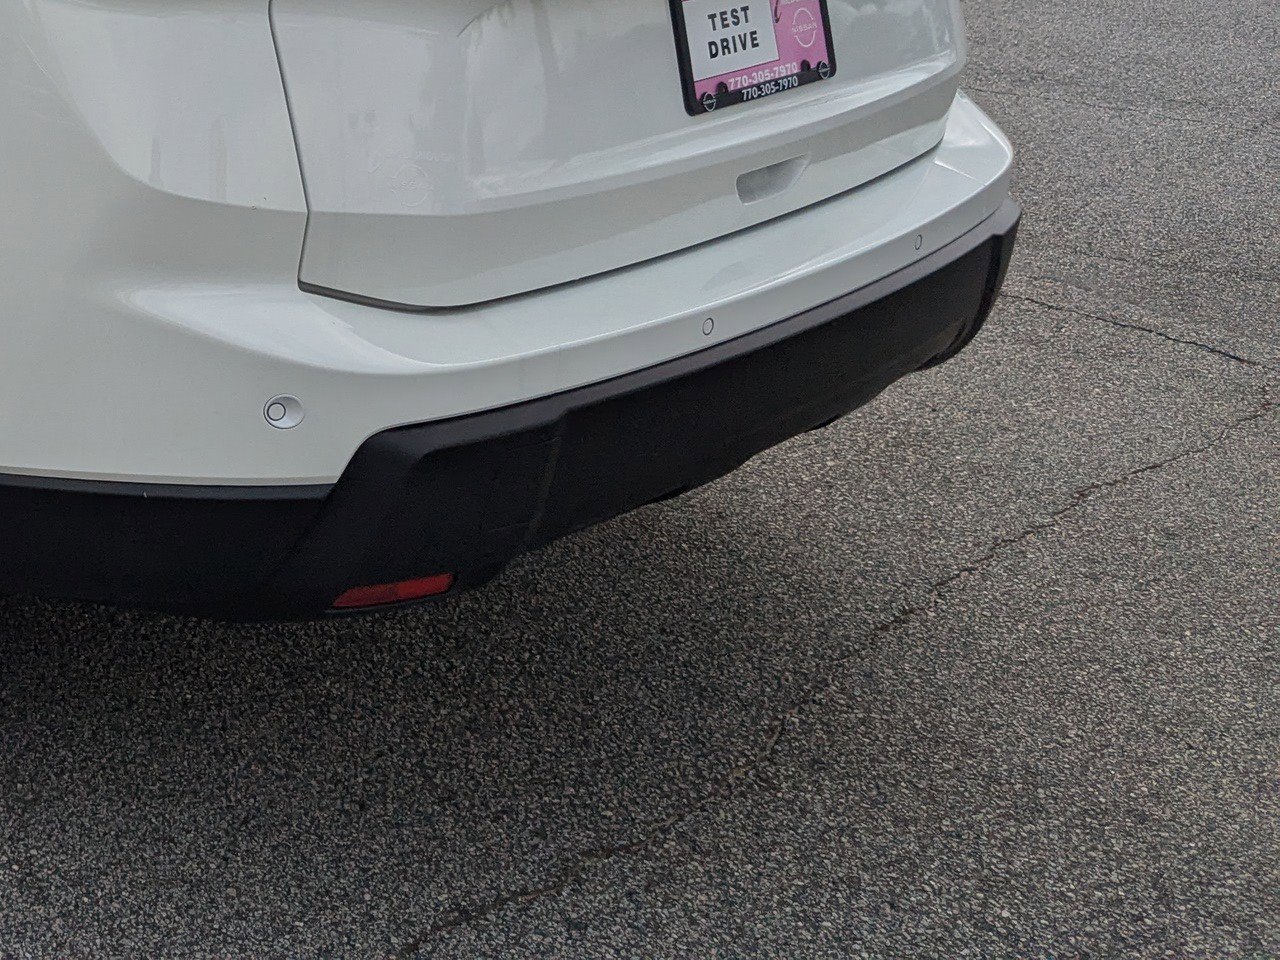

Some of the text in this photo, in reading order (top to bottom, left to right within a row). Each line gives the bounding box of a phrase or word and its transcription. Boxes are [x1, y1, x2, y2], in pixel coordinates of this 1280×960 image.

[707, 5, 750, 32] TEST
[707, 29, 760, 60] DRIVE
[728, 61, 798, 91] 770-305-7970
[741, 75, 799, 101] 770-305-7970
